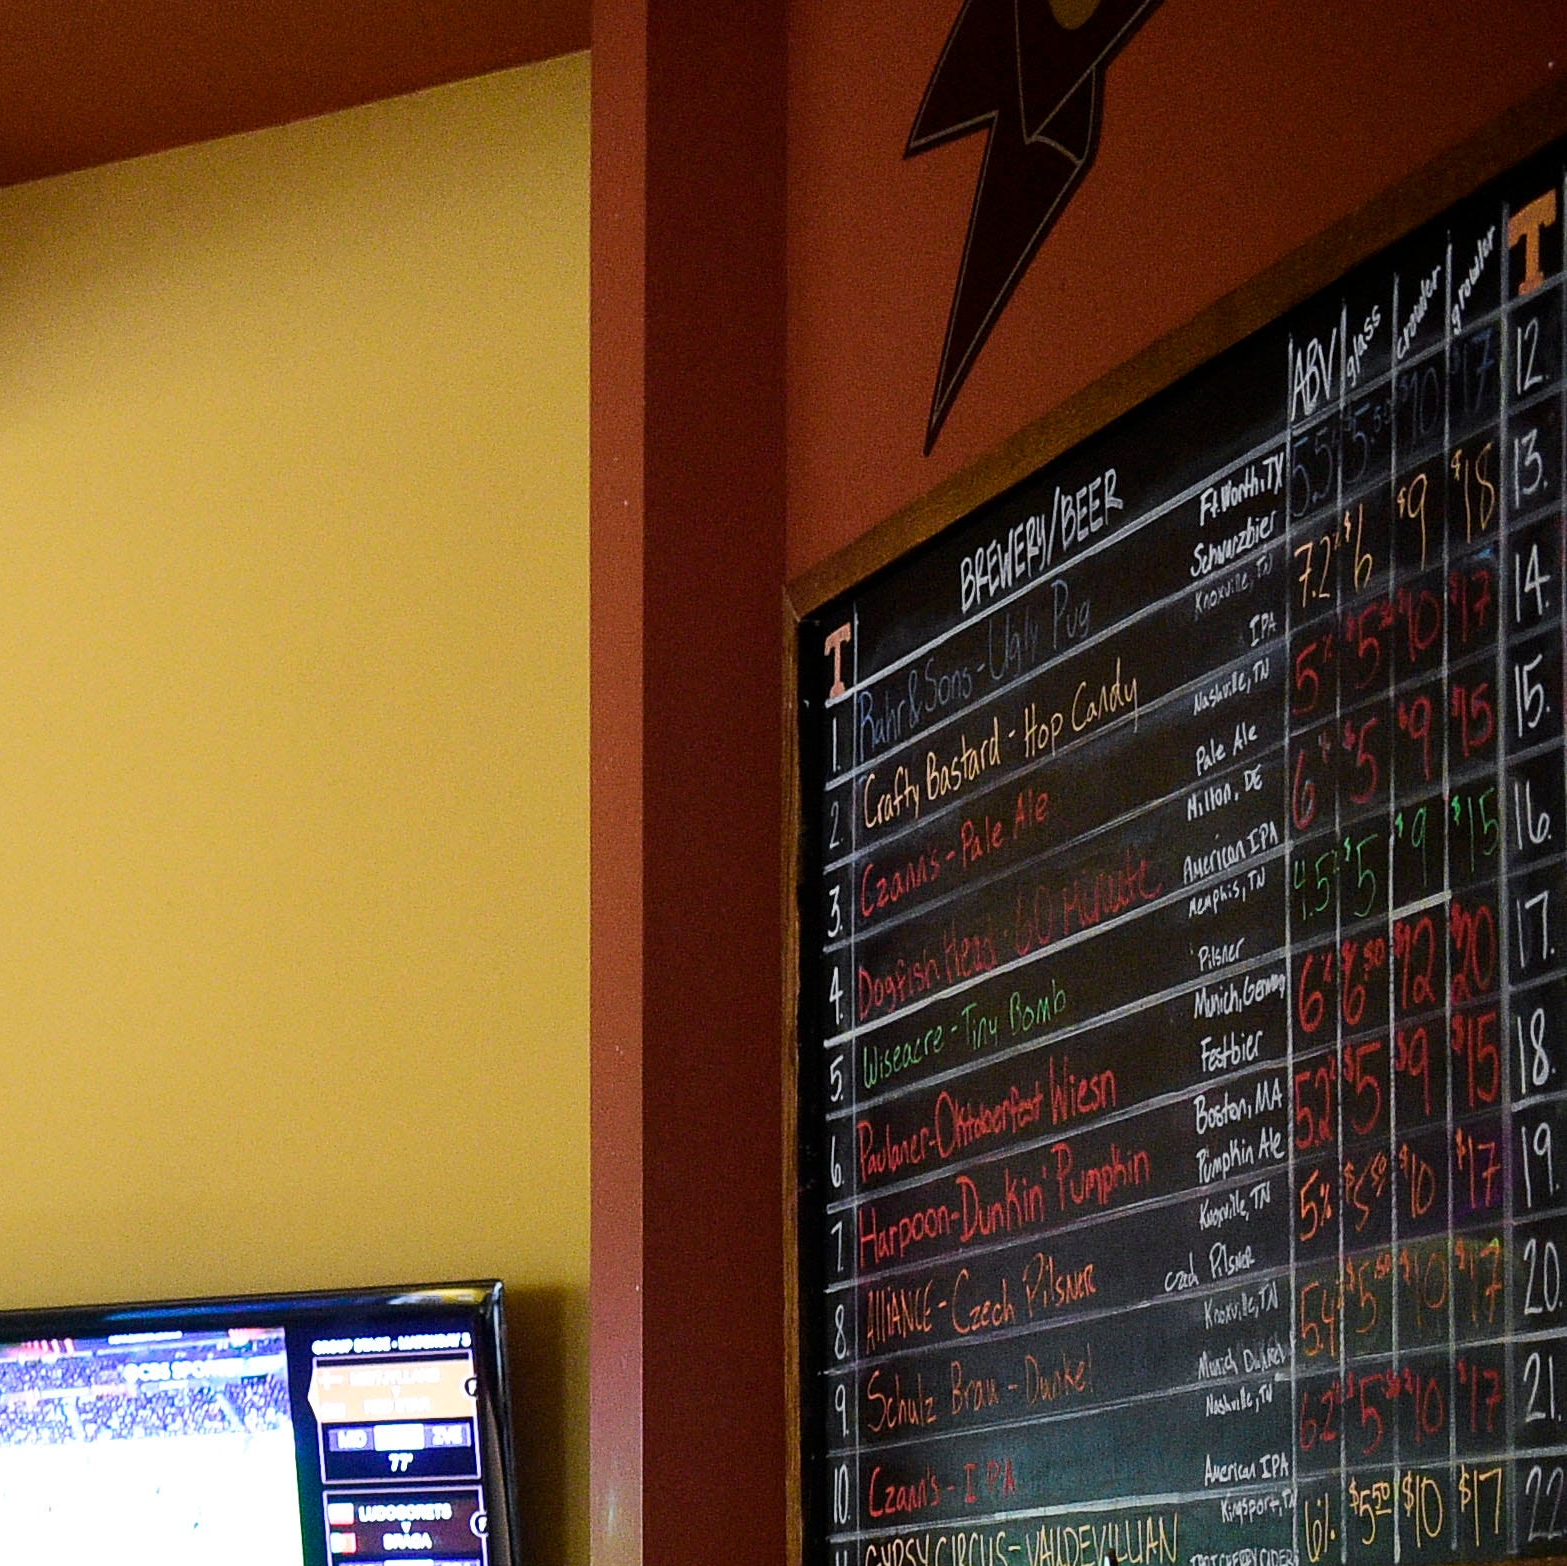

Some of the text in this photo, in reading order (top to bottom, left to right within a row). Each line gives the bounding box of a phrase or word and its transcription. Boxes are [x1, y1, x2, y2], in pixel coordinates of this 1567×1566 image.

[1291, 327, 1337, 421] ABV
[1346, 304, 1382, 388] glass
[1051, 579, 1091, 650] Pug
[1249, 610, 1277, 647] IPA
[862, 766, 920, 829] Crafty
[926, 717, 1000, 801] Bastard
[1024, 703, 1063, 757] Hop
[1071, 657, 1138, 733] Candy
[1195, 722, 1258, 776] Pale Ale
[960, 816, 1004, 868] Pale
[1014, 788, 1049, 840] Ale
[1246, 820, 1279, 855] IPA
[858, 949, 940, 1022] Dogfish
[1198, 937, 1245, 972] Pilsner
[861, 1026, 944, 1089] Wiseacre
[961, 1002, 1000, 1050] Tiny
[1010, 978, 1067, 1036] Bomb
[1200, 1030, 1263, 1073] Festbier
[1049, 1055, 1118, 1125] Wiesn
[1255, 1077, 1283, 1113] MA
[1051, 1142, 1152, 1210] Pumpkin
[1196, 1126, 1285, 1184] Pumpkin Ale
[951, 1268, 1016, 1334] Czech
[867, 1369, 938, 1434] Schulz
[951, 1360, 999, 1415] Brau
[1205, 1452, 1289, 1487] American IPA
[1403, 1470, 1444, 1548] $10
[1459, 1464, 1503, 1547] $17
